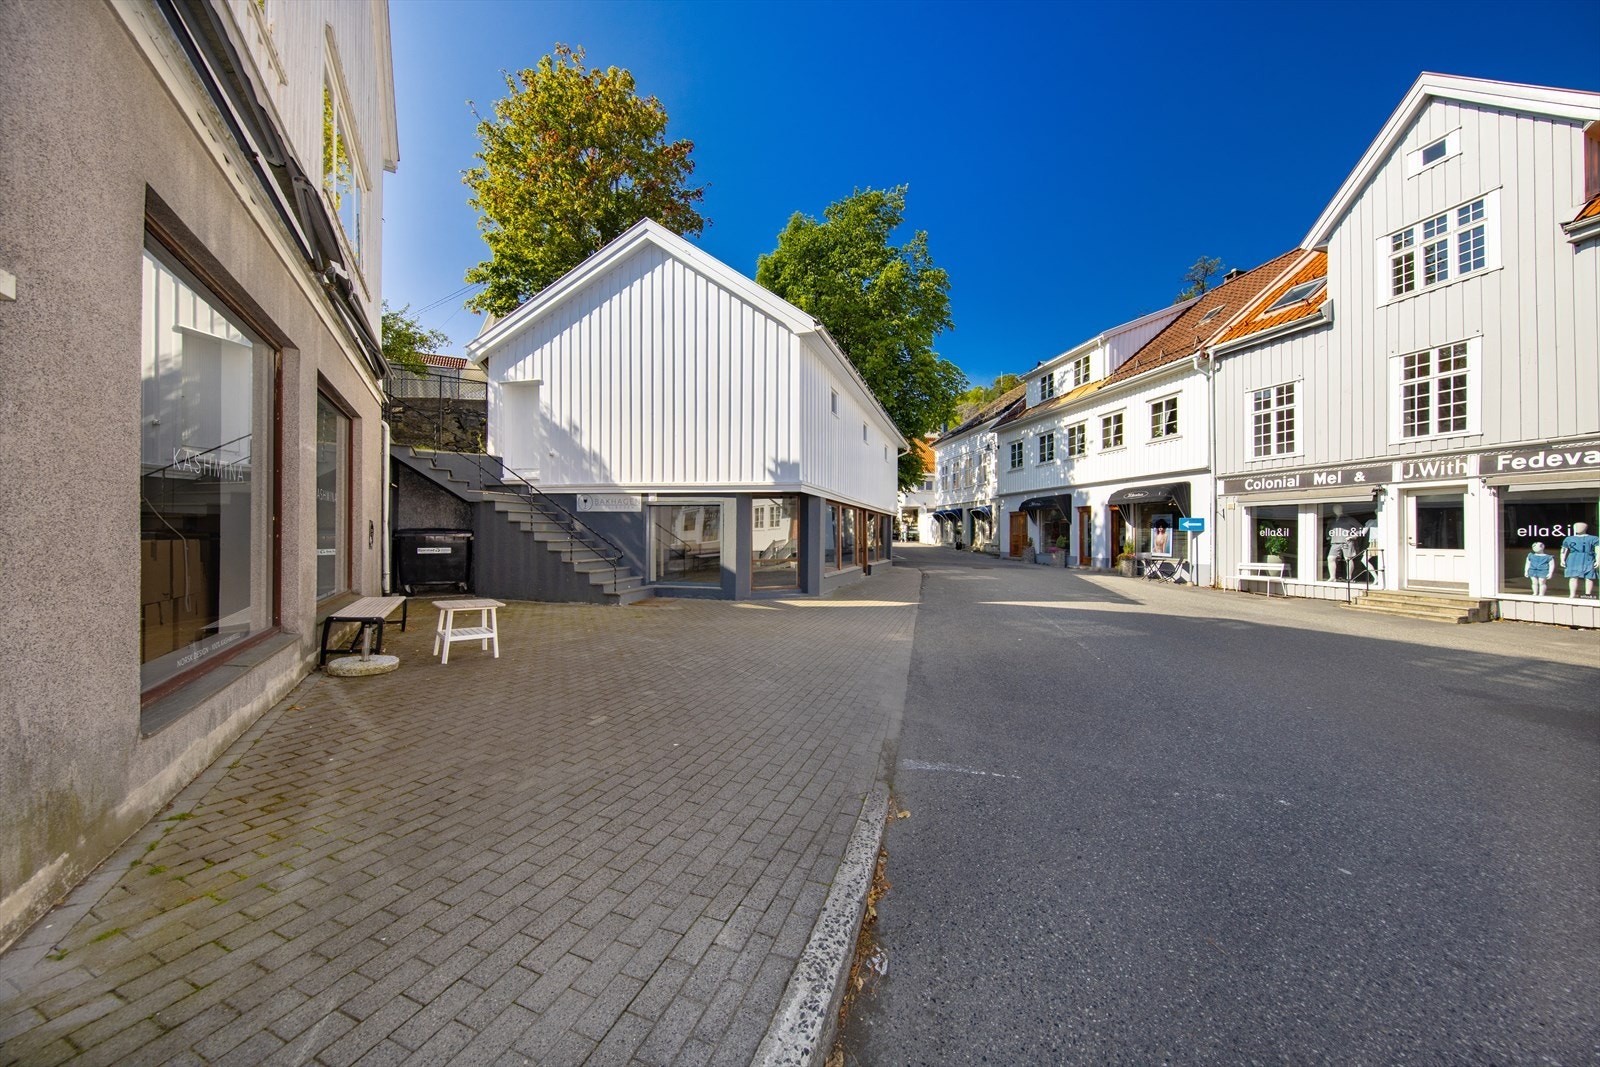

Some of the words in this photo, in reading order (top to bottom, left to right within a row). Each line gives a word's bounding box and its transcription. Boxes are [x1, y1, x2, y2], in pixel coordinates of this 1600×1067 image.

[173, 447, 245, 483] KASHMINA
[1403, 459, 1468, 479] J.With
[1497, 450, 1600, 471] Fedeva
[1244, 474, 1300, 491] Colonial
[1313, 470, 1342, 486] Mel
[1353, 471, 1366, 483] &
[1259, 527, 1290, 537] ella&il
